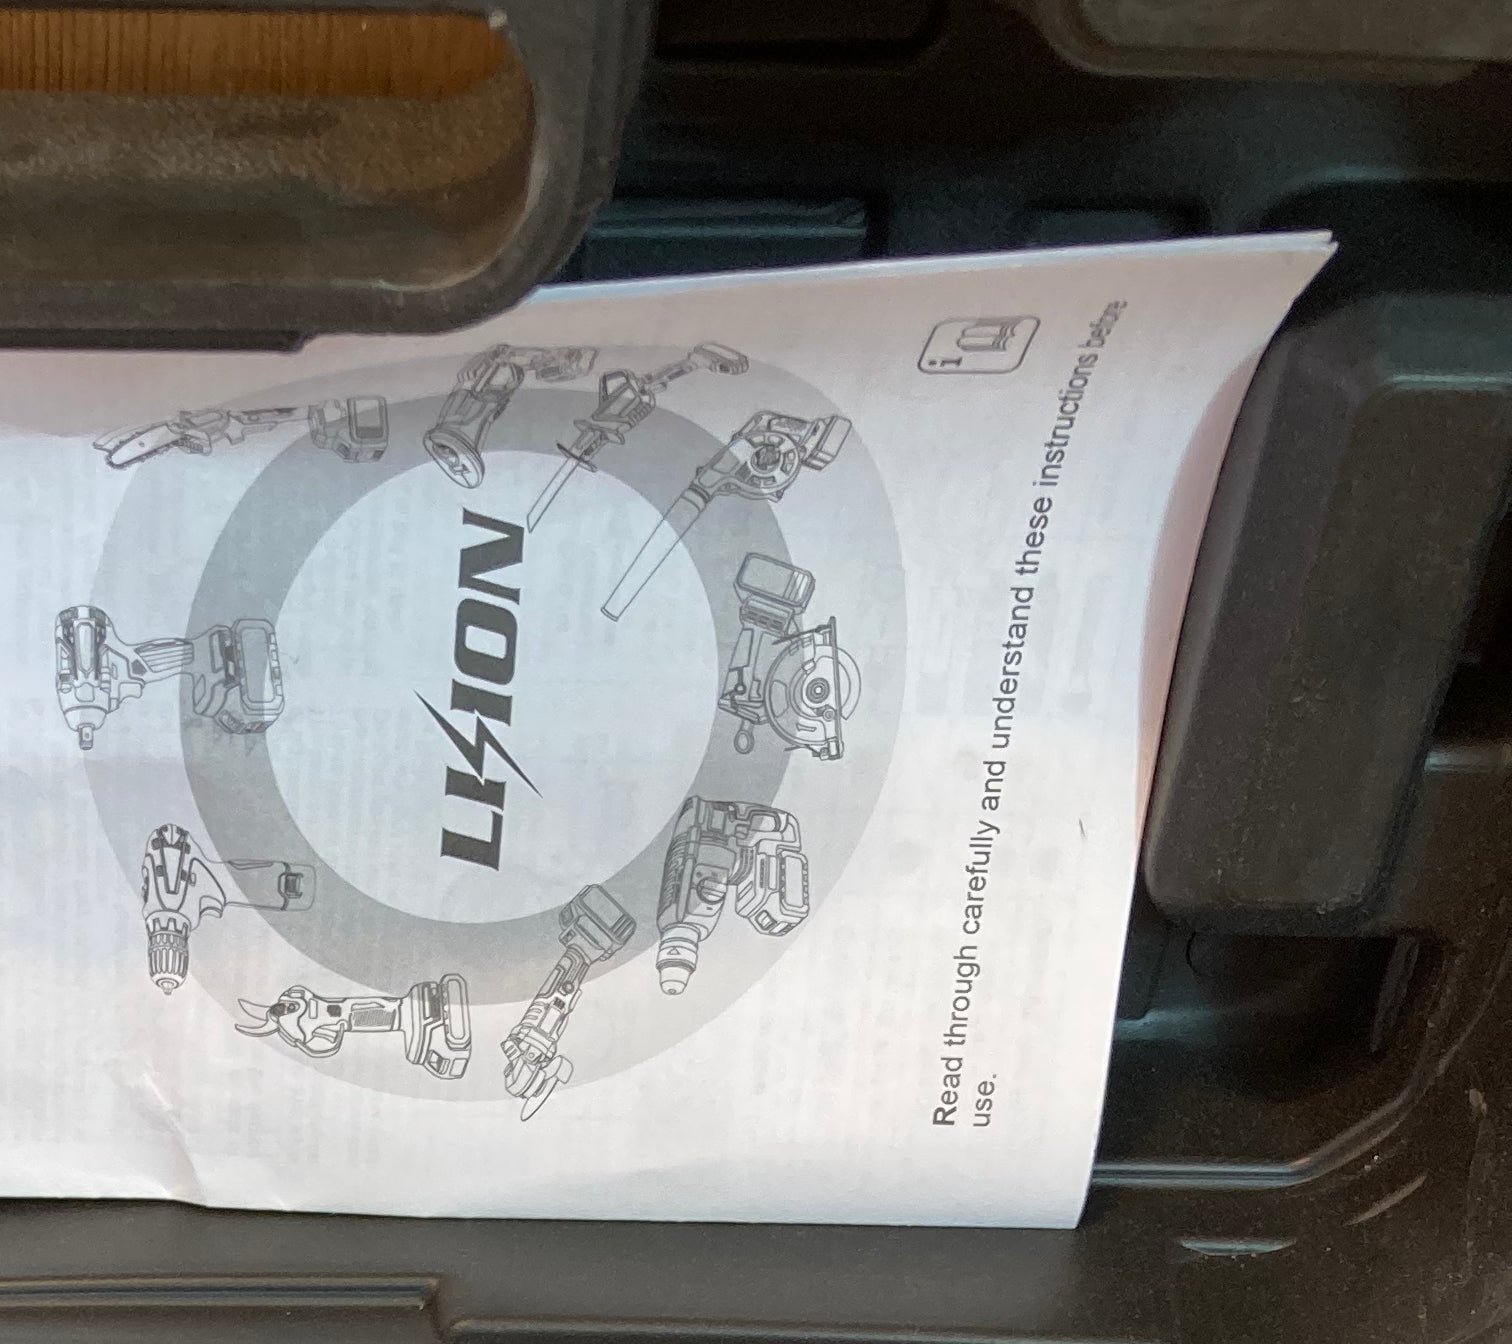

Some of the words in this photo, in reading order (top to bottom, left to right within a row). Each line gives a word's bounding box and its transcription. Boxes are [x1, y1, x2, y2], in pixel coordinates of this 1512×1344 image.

[1032, 351, 1099, 488] instructions
[1016, 495, 1053, 576] these
[992, 586, 1035, 749] understand
[981, 760, 1006, 811] and
[962, 818, 1001, 936] carefully
[943, 945, 982, 1048] through
[932, 1056, 964, 1127] Read
[972, 1073, 998, 1128] use.
